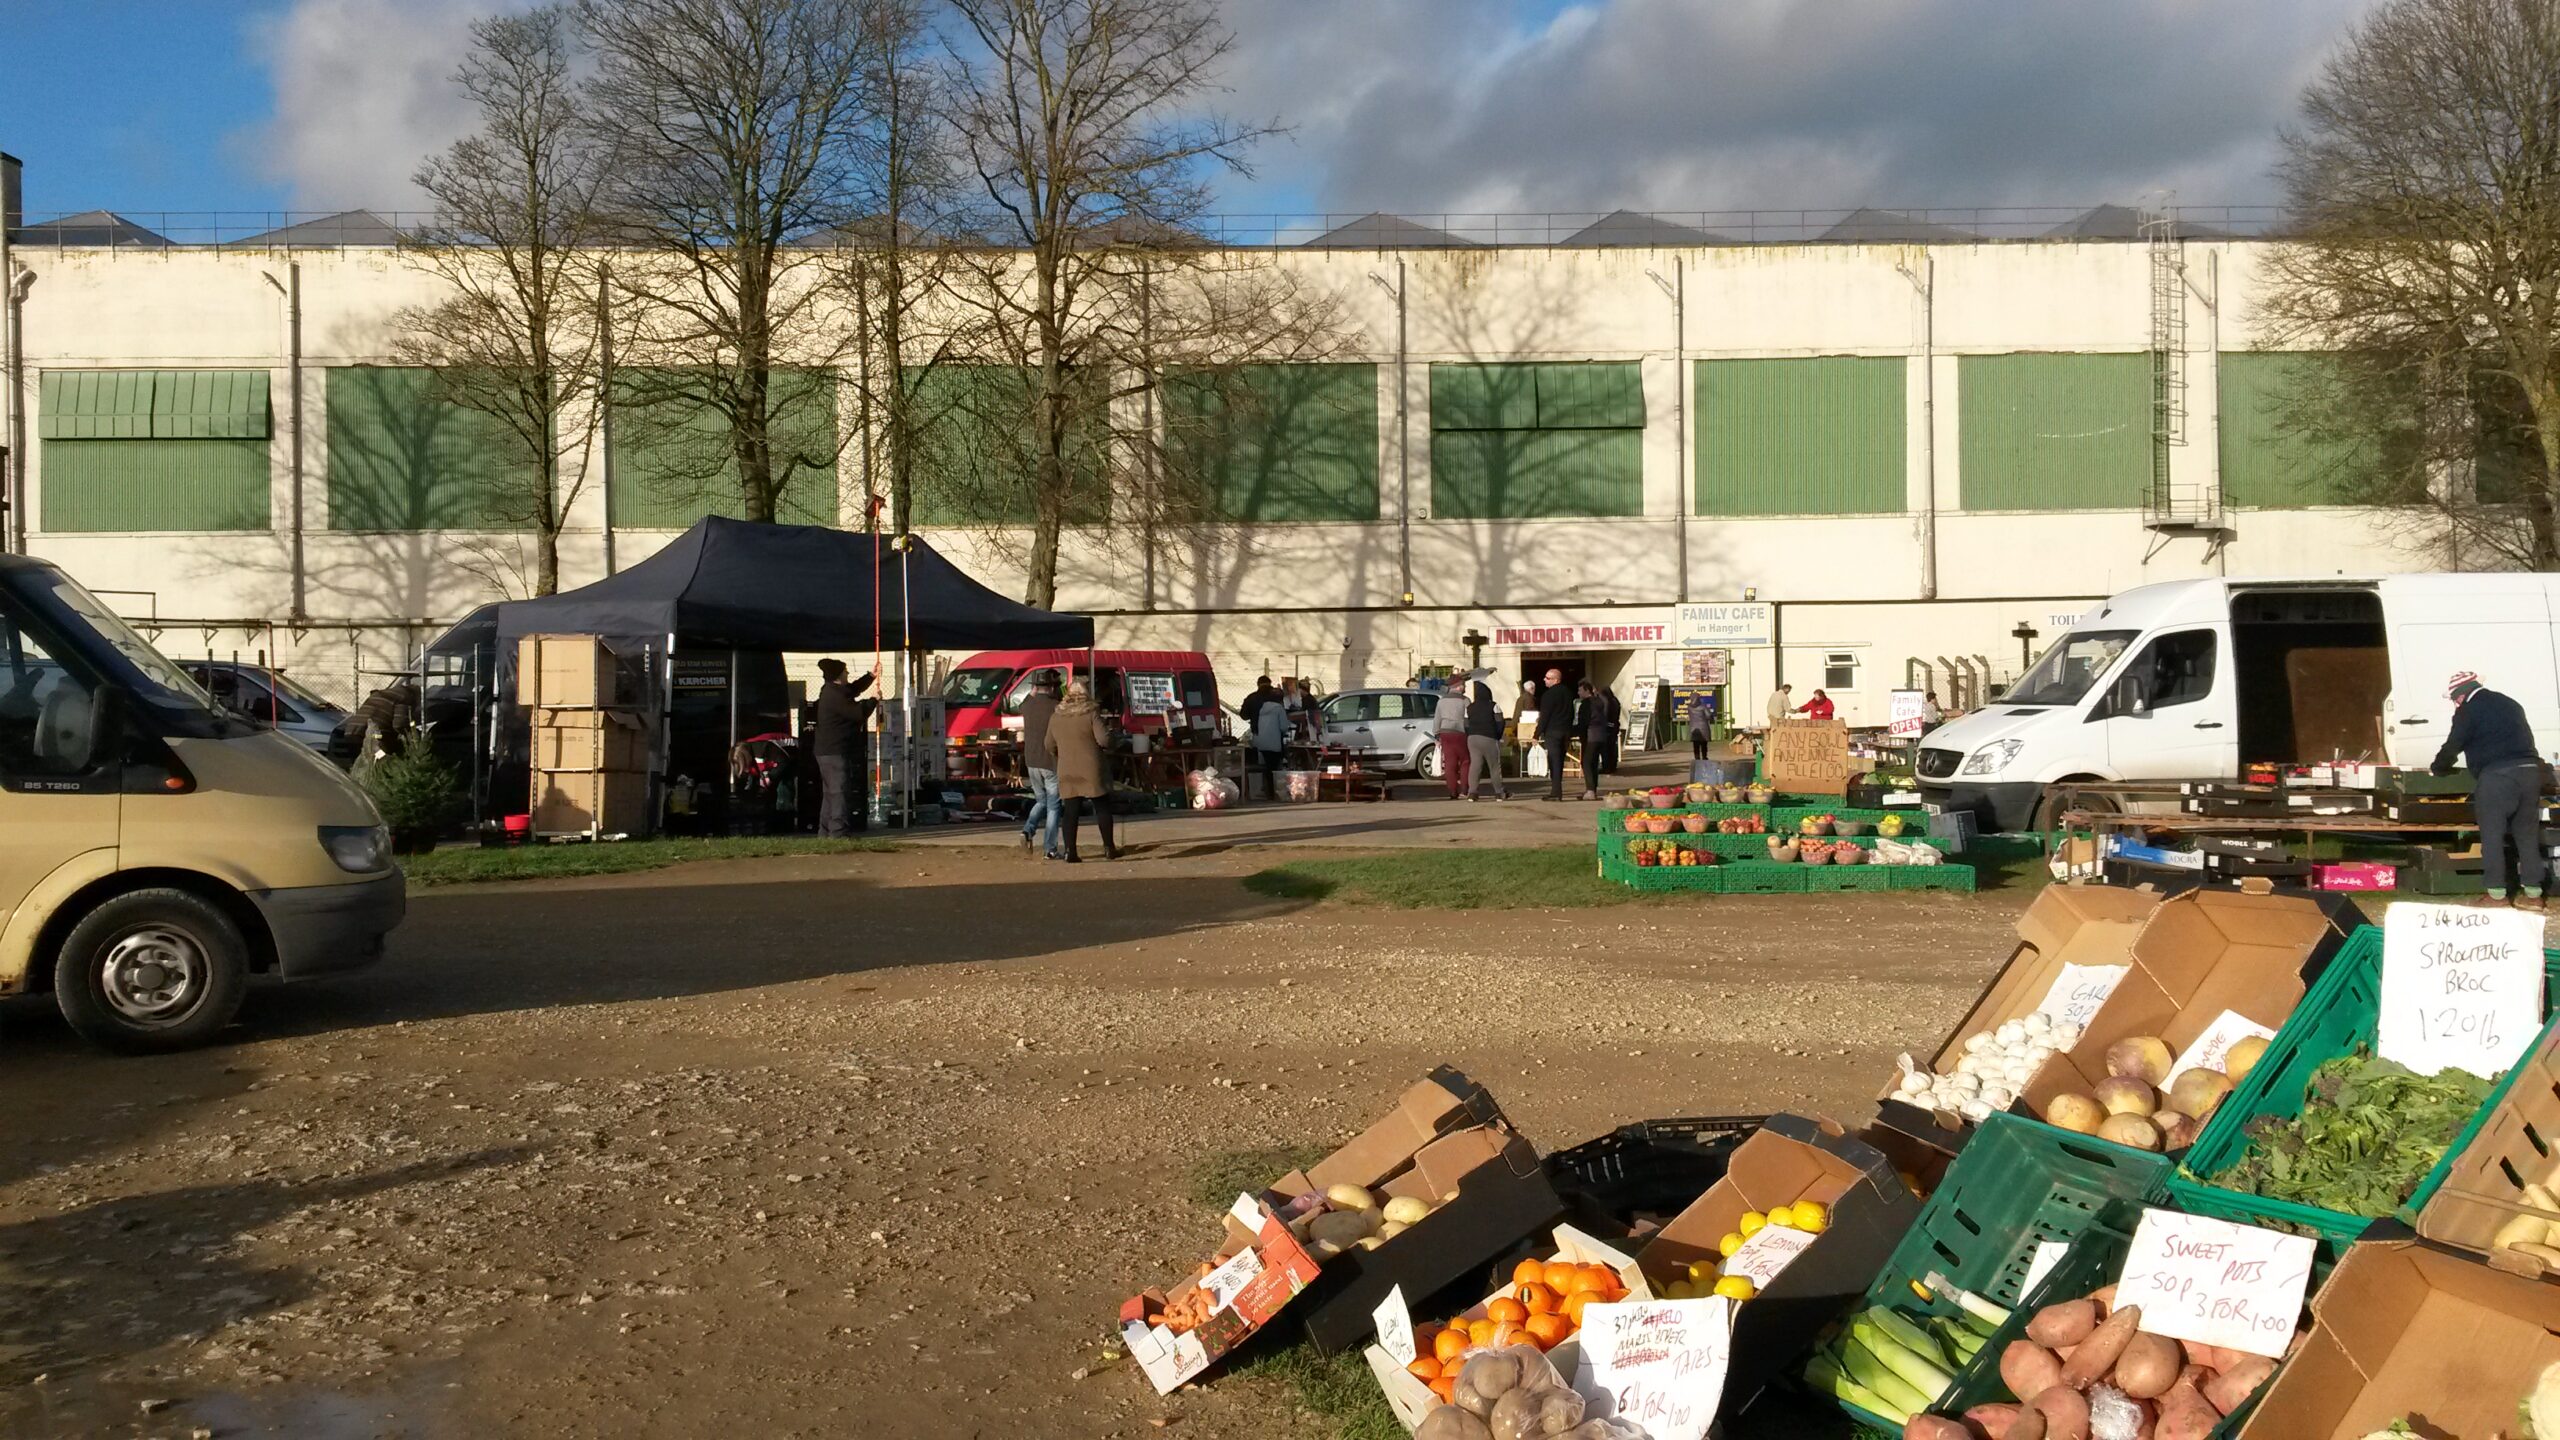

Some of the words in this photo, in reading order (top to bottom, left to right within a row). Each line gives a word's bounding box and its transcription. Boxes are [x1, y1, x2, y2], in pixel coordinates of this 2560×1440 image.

[1682, 607, 1728, 621] FAMILY
[1731, 606, 1765, 620] CAFE
[1495, 627, 1574, 645] INDOOR
[1581, 624, 1666, 642] MARKET
[1697, 623, 1707, 633] in
[1709, 623, 1743, 635] Hanger
[1746, 623, 1751, 633] 1
[1892, 694, 1922, 705] Family
[1896, 707, 1916, 716] Cafe
[1891, 718, 1920, 734] OPEN
[1777, 731, 1807, 748] ANY
[1808, 731, 1846, 749] BOWL
[2221, 839, 2249, 847] NOBLE
[2420, 940, 2519, 970] SPROUTING
[2445, 969, 2497, 995] BROC
[2161, 1234, 2234, 1263] SWEET
[2220, 1259, 2268, 1286] POTS
[1268, 1275, 1283, 1290] used
[1241, 1290, 1254, 1302] The
[1258, 1294, 1274, 1309] taste
[2195, 1292, 2207, 1318] 3
[2210, 1297, 2250, 1322] FOR
[1642, 1392, 1667, 1422] FOR
